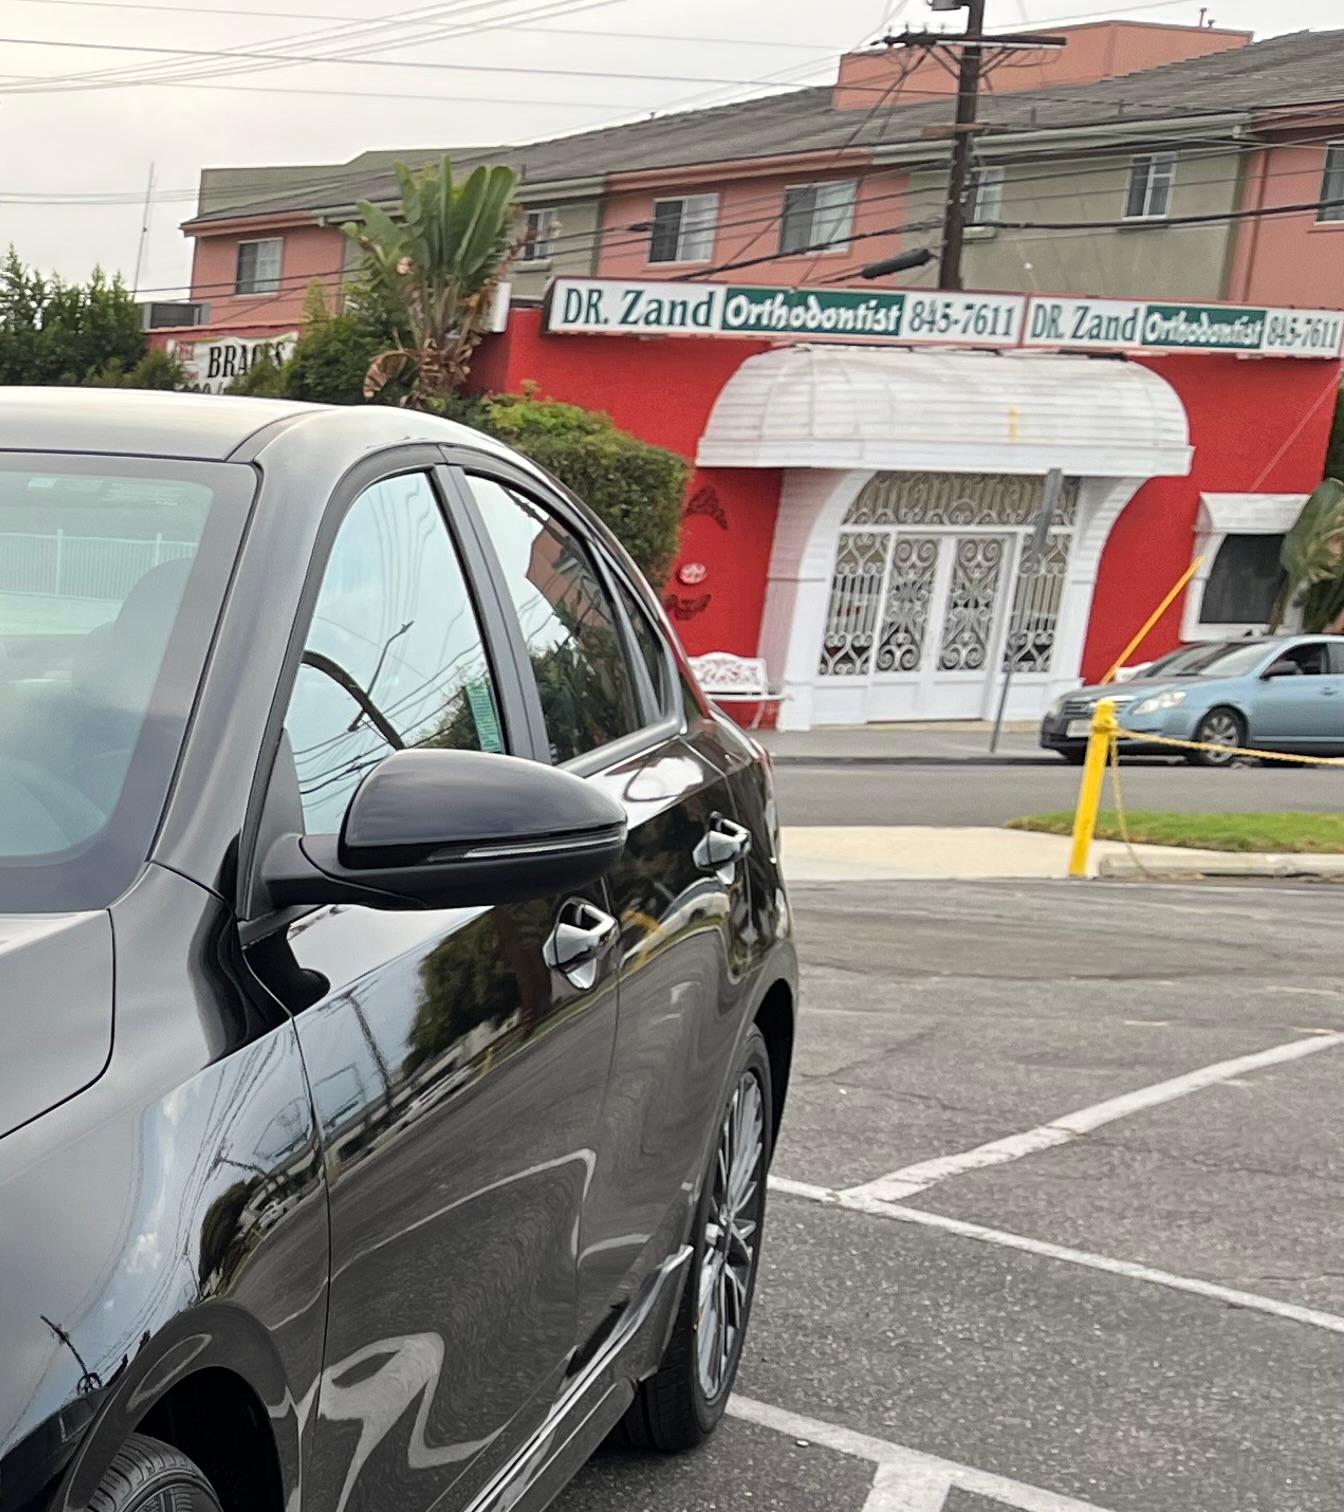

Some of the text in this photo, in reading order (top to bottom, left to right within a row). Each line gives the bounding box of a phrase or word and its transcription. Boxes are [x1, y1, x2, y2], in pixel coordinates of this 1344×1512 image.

[562, 287, 1014, 337] DR. Zand Orthodontist 845-7611
[1072, 305, 1140, 341] Zand
[1143, 309, 1263, 345] Orthodontist
[1266, 315, 1340, 349] 845-7611
